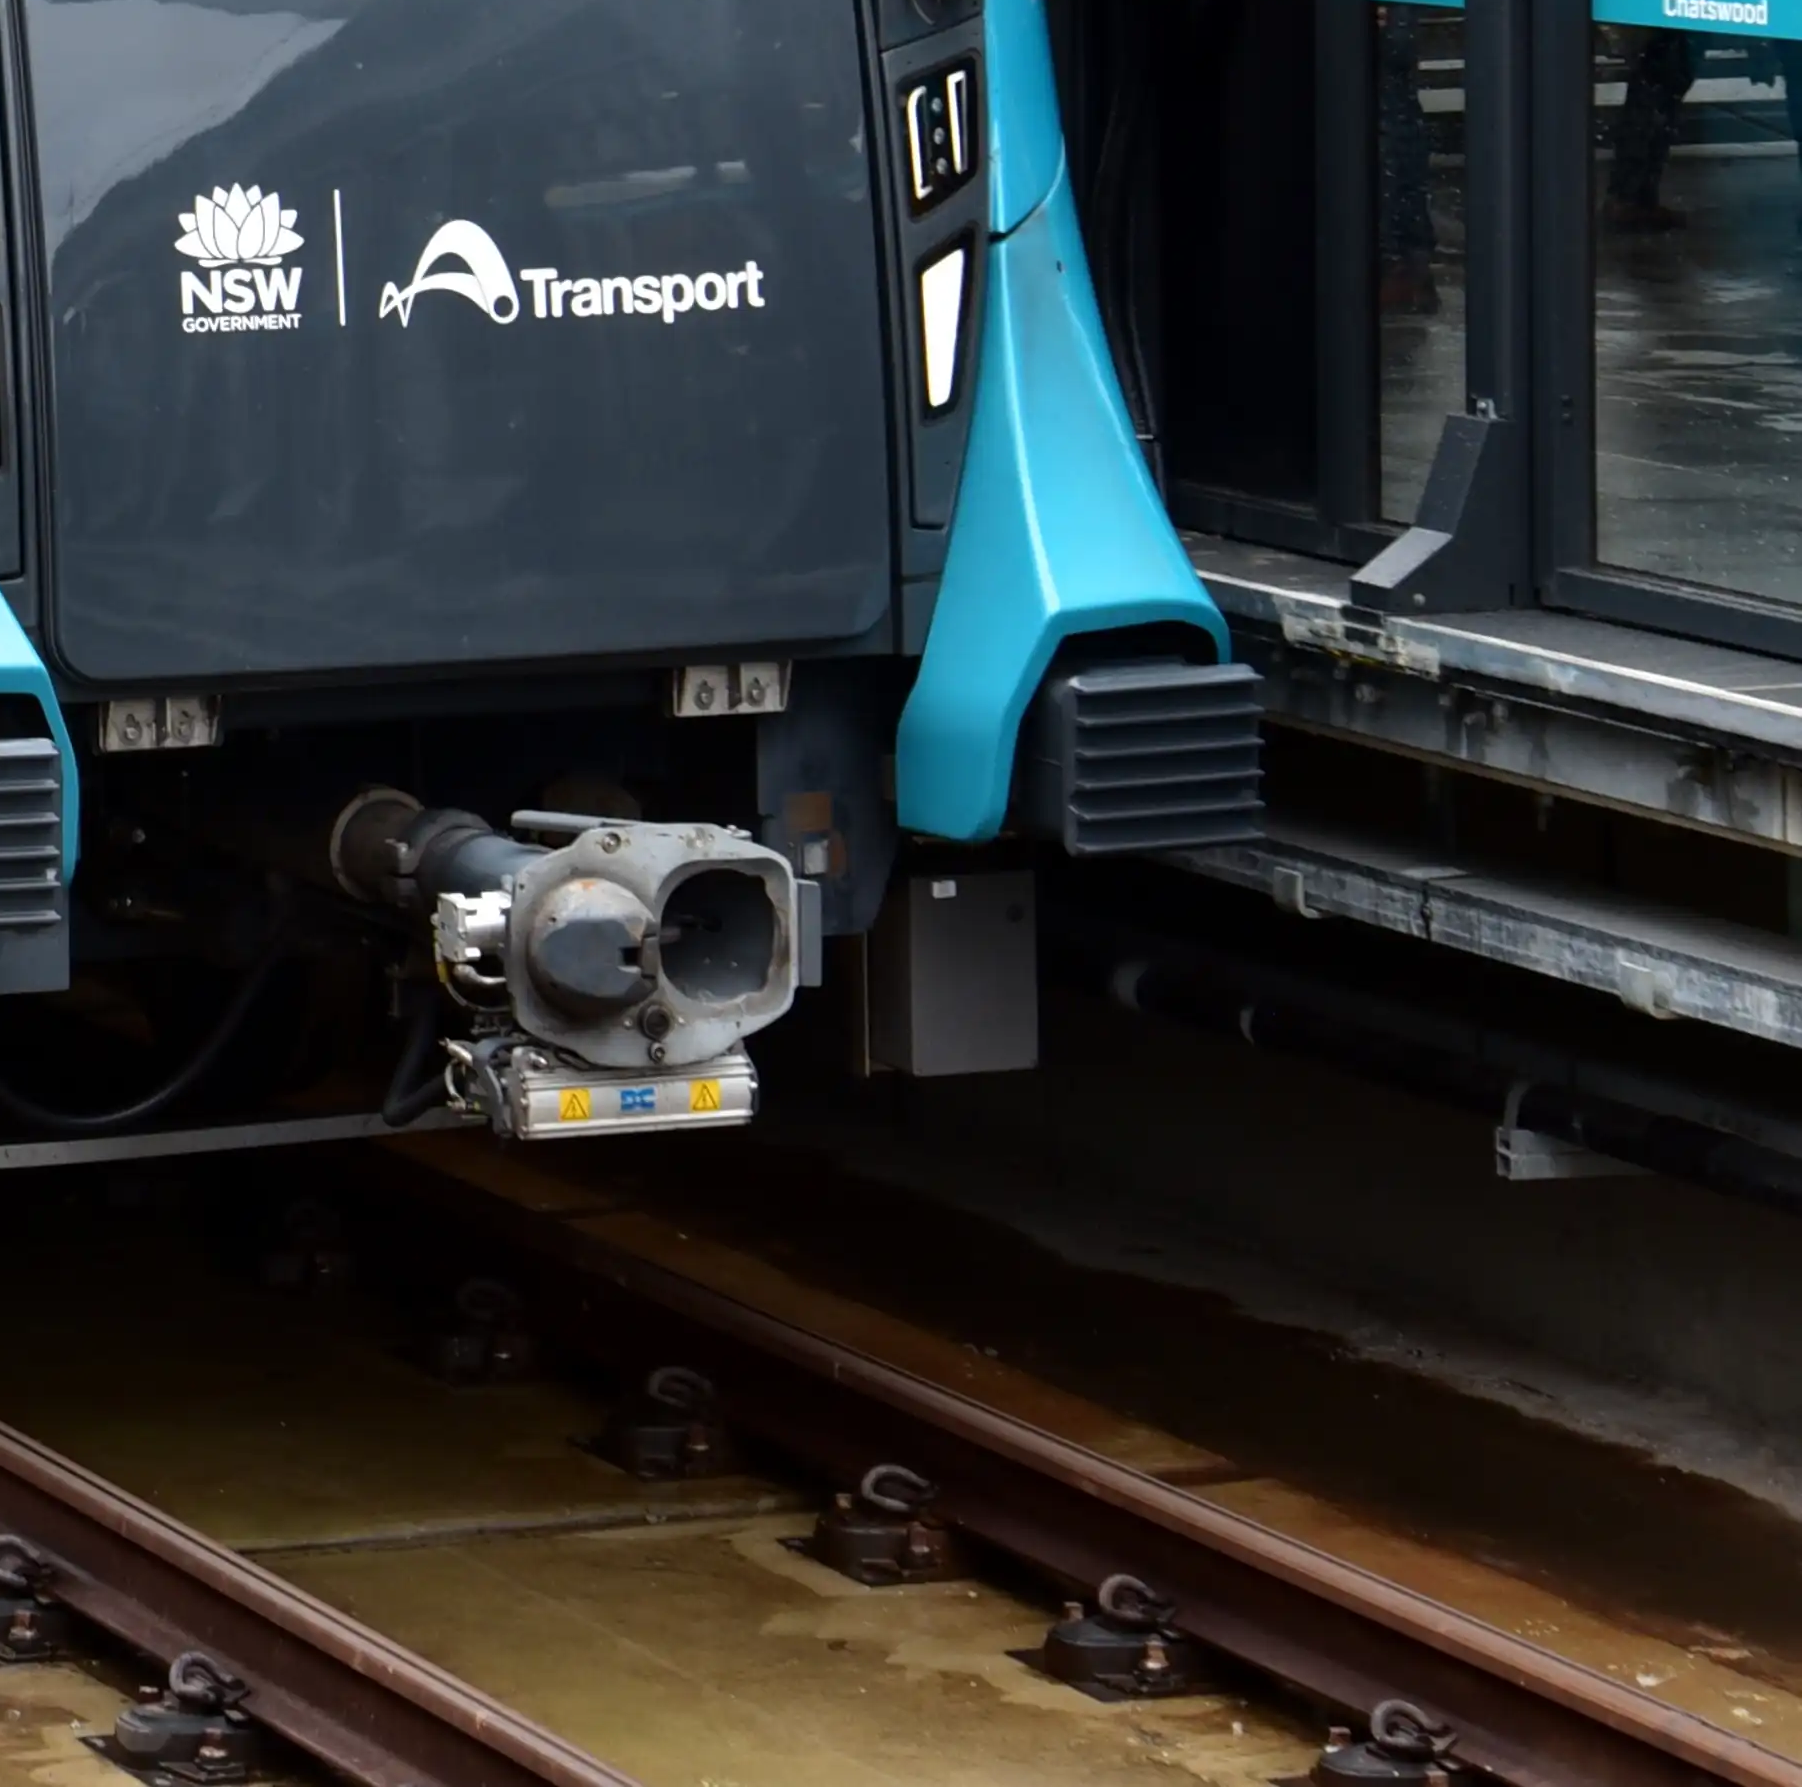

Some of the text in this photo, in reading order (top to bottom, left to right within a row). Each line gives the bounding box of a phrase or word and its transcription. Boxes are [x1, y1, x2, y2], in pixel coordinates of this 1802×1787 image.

[180, 267, 303, 314] NSW
[520, 261, 765, 323] Transport
[182, 313, 302, 334] GOVERNMENT
